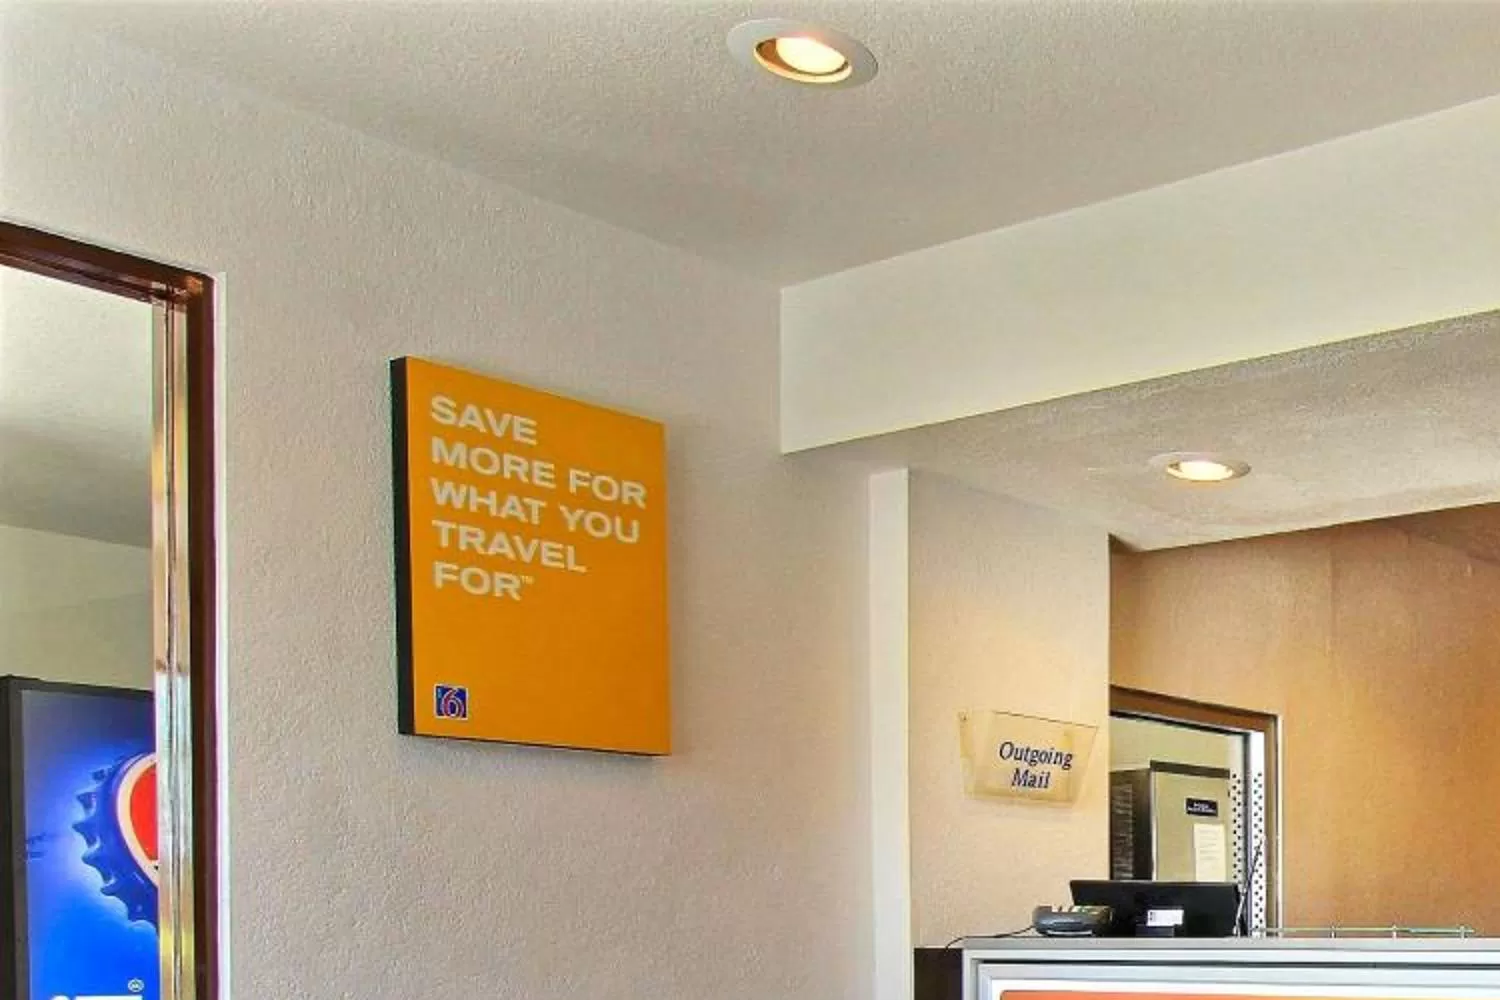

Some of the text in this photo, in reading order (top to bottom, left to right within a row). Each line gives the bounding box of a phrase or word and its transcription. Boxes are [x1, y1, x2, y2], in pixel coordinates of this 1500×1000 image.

[430, 395, 539, 446] SAVE
[430, 436, 647, 509] MORE FOR
[430, 477, 641, 544] WHAT YOU
[431, 519, 589, 573] TRAVEL
[999, 741, 1073, 771] Outgoing
[1011, 768, 1051, 788] Mail
